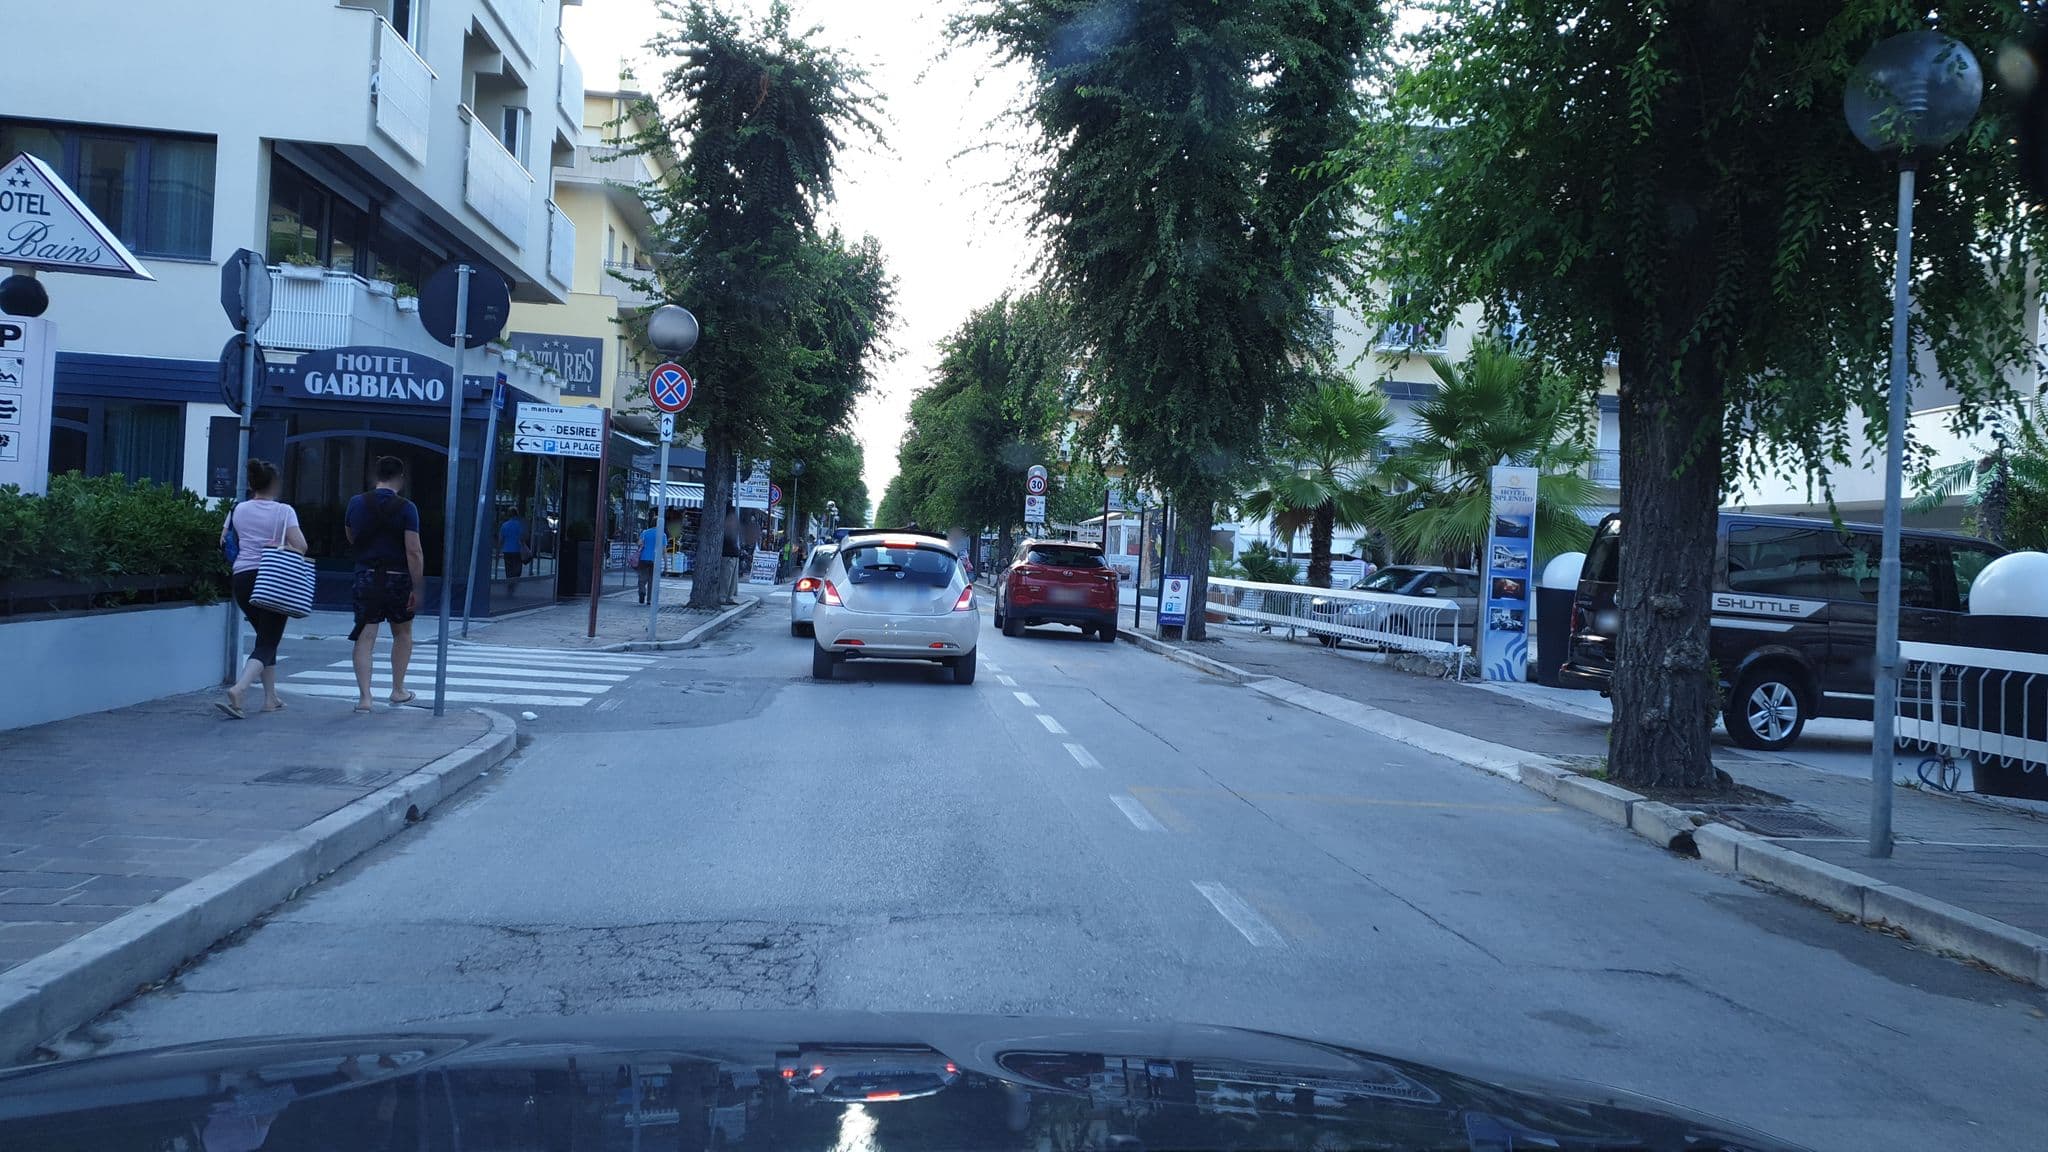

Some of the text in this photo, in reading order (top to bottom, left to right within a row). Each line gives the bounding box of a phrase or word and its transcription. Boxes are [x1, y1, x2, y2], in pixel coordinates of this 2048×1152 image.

[0, 220, 101, 263] Bains
[336, 353, 415, 375] HOTEL
[304, 371, 445, 402] GABBIANO
[531, 406, 563, 414] mantova
[559, 441, 570, 450] LA
[573, 442, 601, 452] PLAGE
[1031, 480, 1043, 489] 30
[1717, 598, 1801, 613] SHUTTLE
